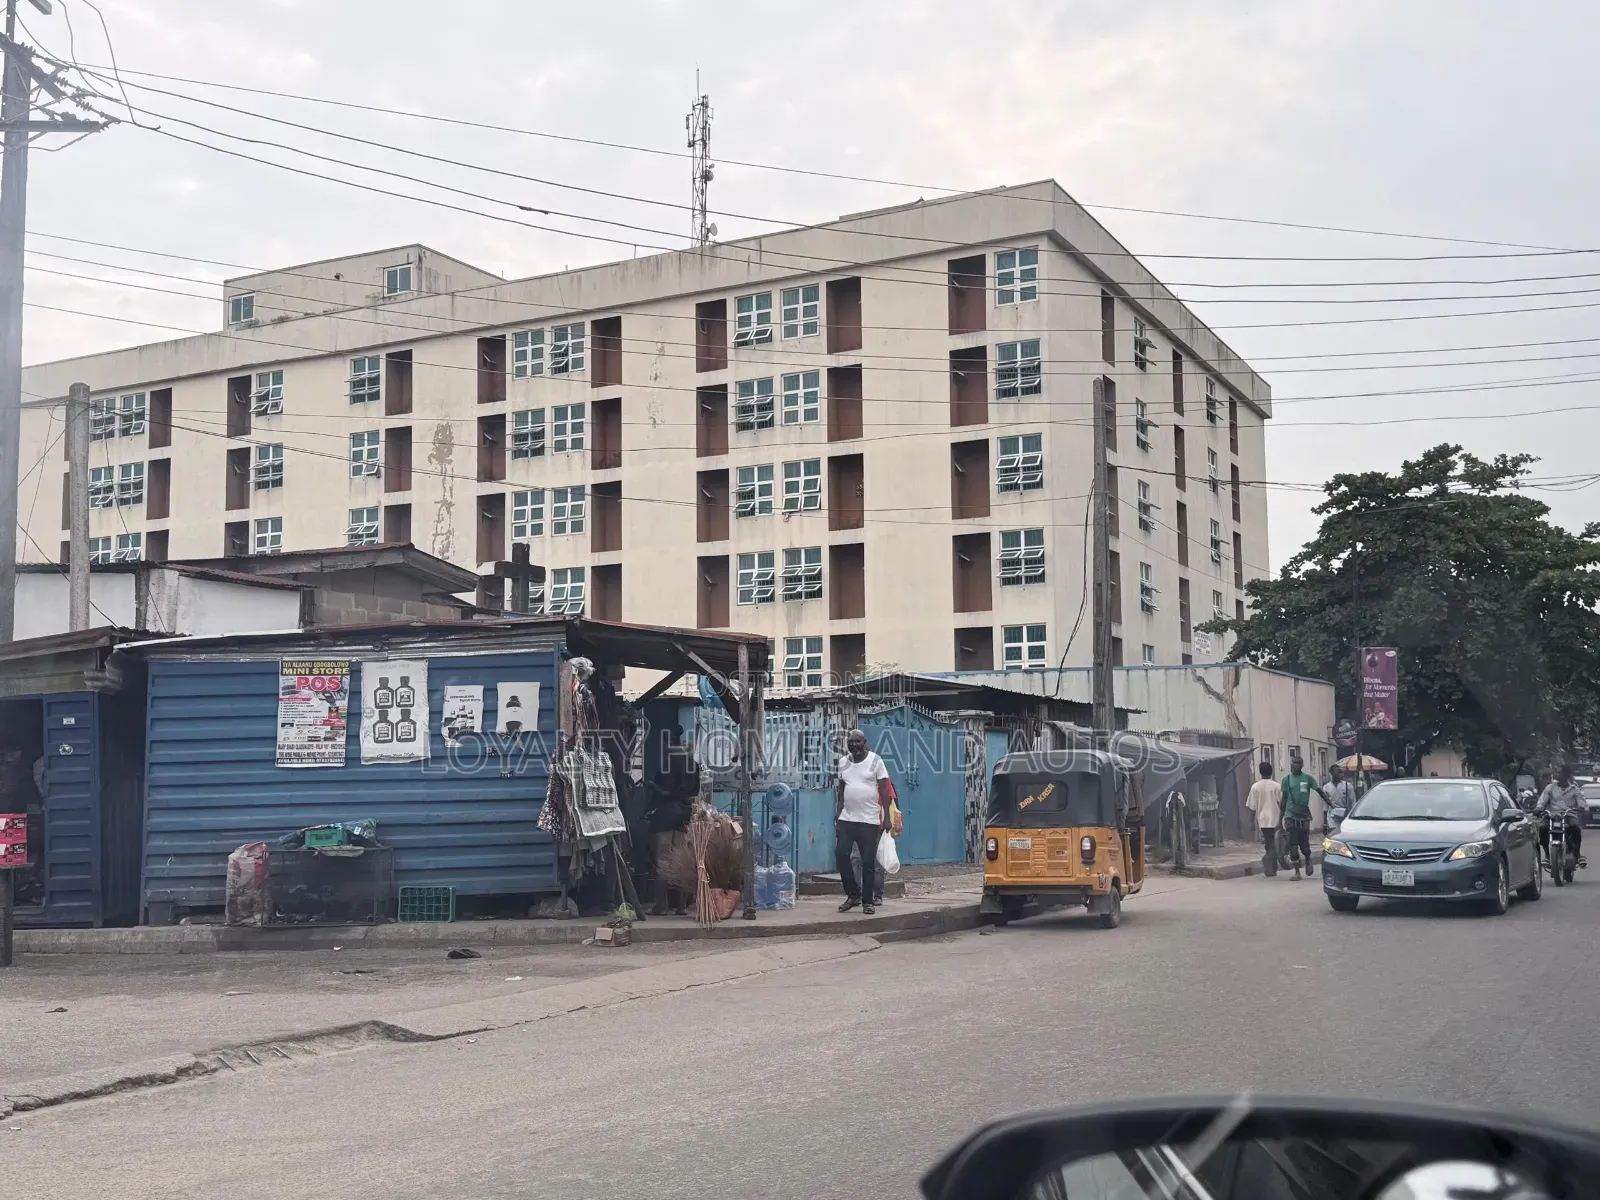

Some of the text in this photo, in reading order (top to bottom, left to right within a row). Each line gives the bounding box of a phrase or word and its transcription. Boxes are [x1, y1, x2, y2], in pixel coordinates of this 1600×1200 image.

[282, 667, 350, 675] MINI STORE
[295, 675, 341, 692] POS
